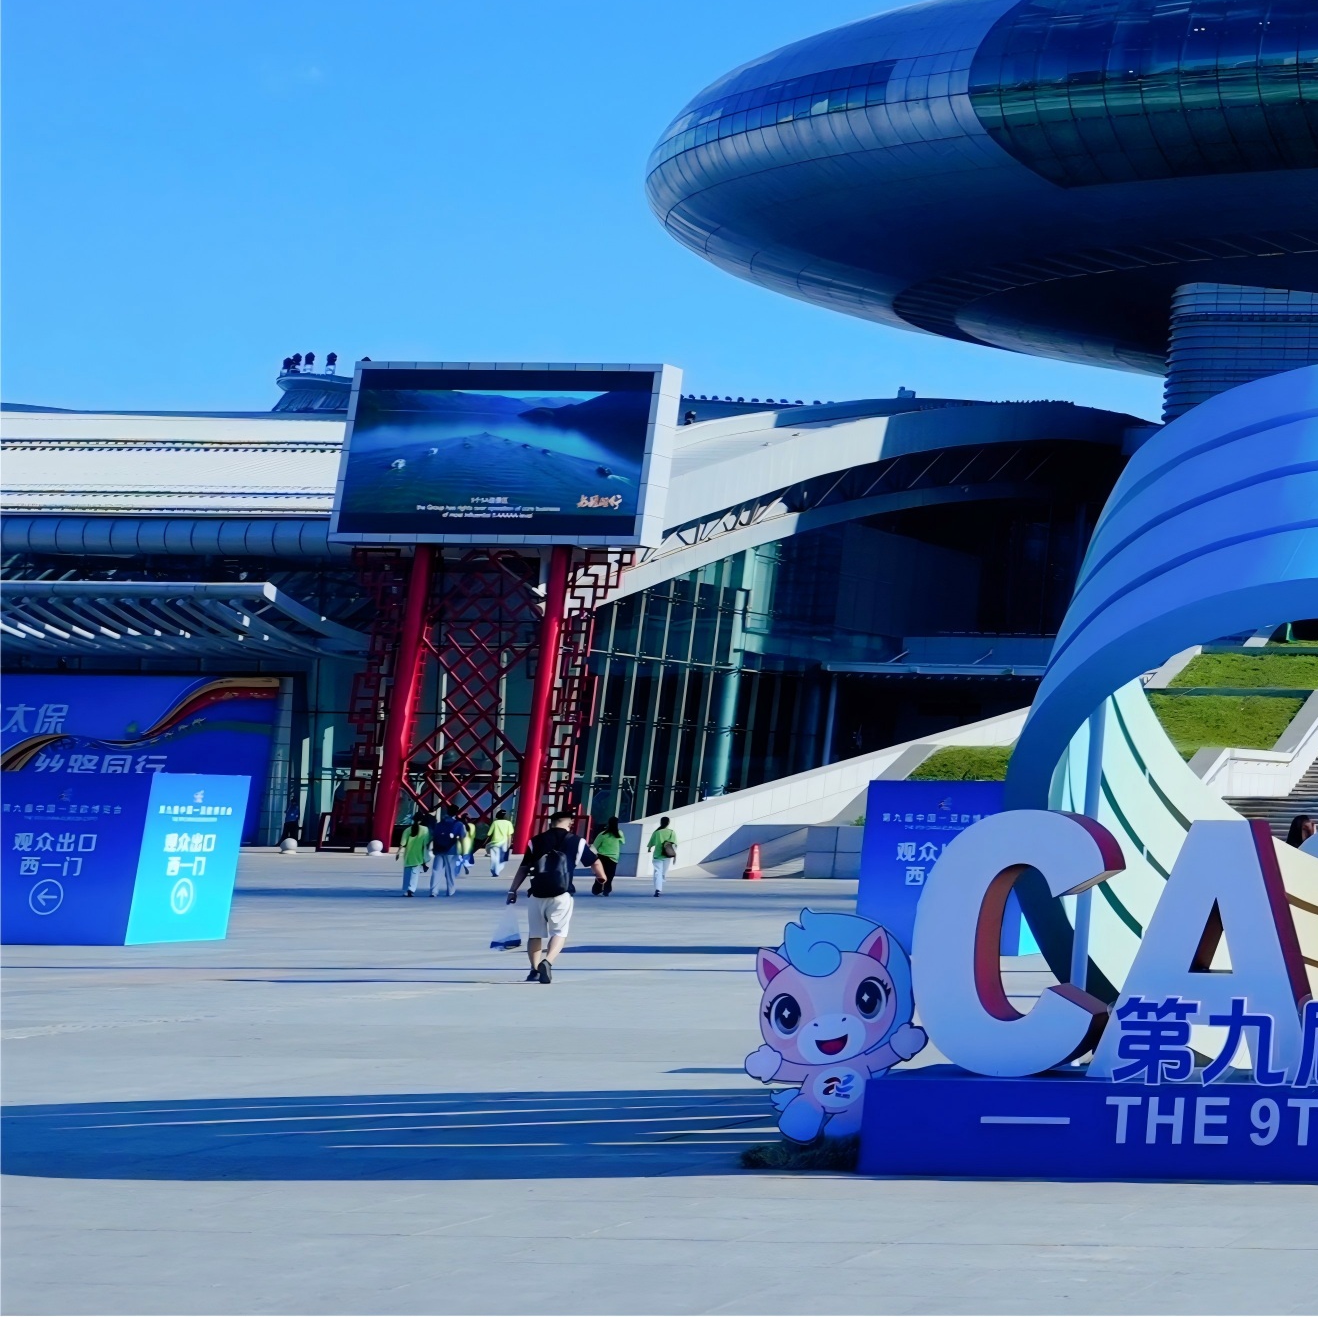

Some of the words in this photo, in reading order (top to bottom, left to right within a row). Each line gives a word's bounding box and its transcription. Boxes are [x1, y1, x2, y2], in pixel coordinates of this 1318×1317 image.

[12, 832, 98, 852] 观众出口
[163, 833, 217, 853] 观众出口
[896, 841, 949, 861] 观众
[19, 856, 83, 876] 西一门
[166, 856, 206, 876] 西一门
[1106, 1096, 1230, 1145] THE
